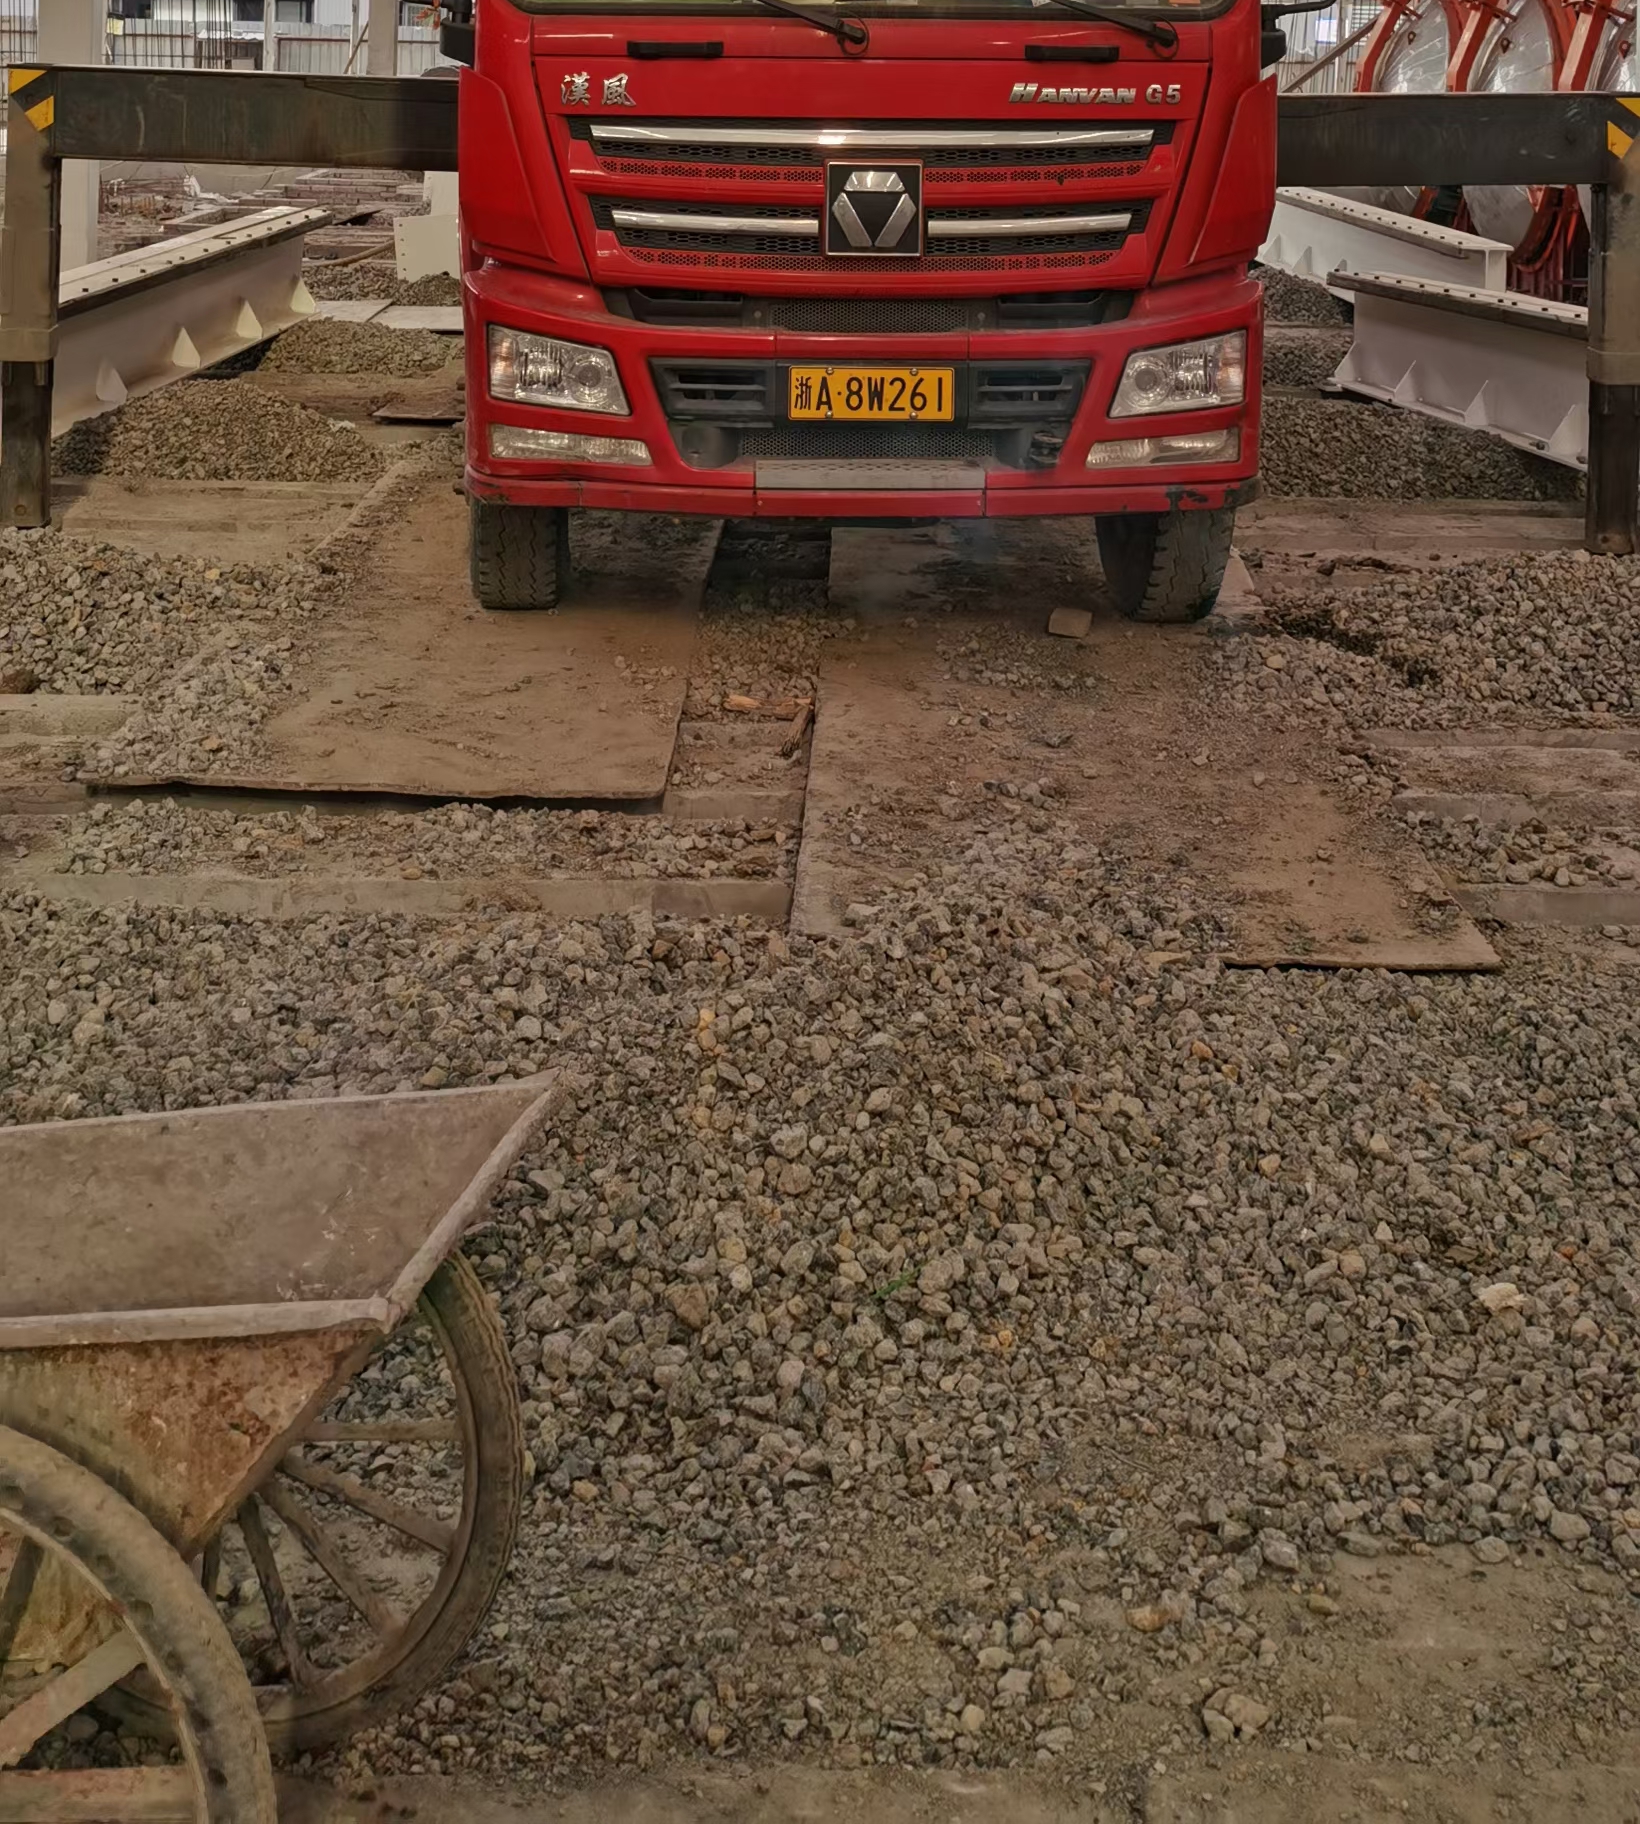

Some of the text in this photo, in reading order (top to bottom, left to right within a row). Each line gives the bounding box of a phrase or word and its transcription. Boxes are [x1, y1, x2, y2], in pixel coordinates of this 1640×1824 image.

[561, 71, 637, 107] 漢風
[1008, 83, 1181, 105] HANVAN G5
